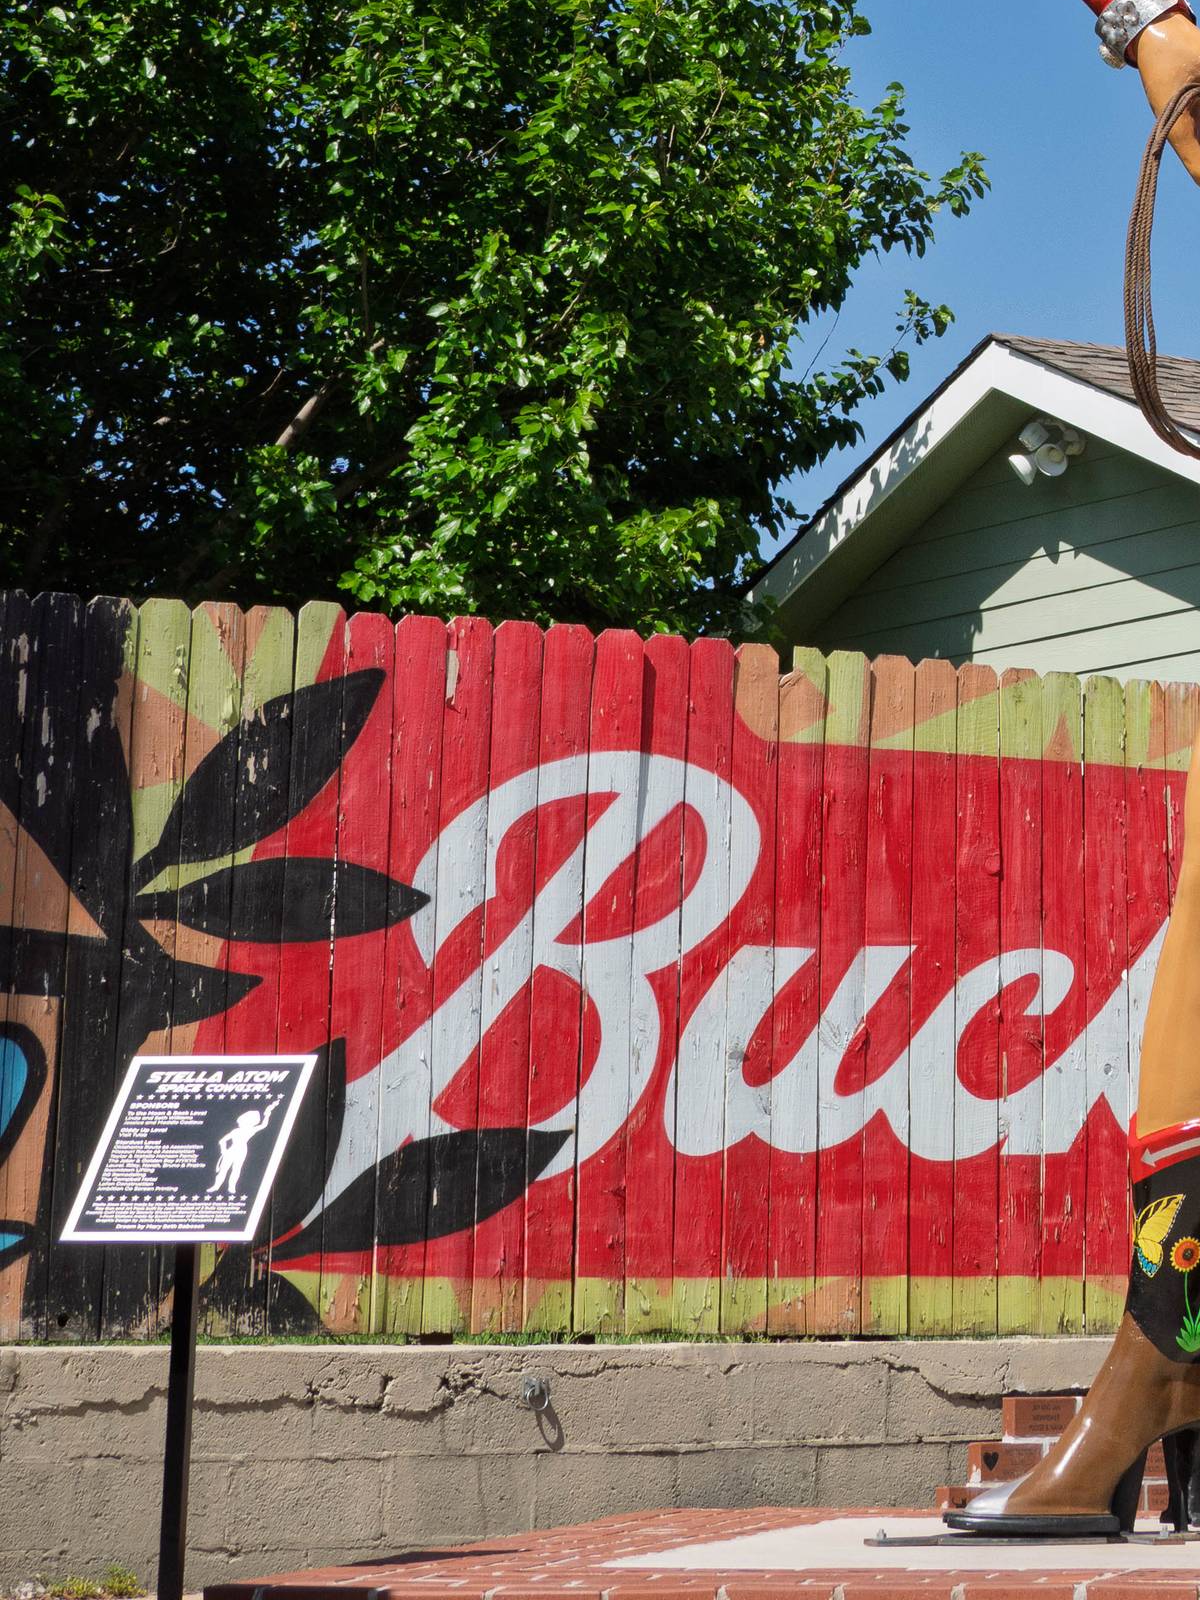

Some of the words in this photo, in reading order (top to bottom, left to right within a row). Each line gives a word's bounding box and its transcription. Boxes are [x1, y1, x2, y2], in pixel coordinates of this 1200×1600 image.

[146, 1071, 223, 1083] STELLA
[228, 1071, 289, 1083] ATOM
[156, 1083, 203, 1093] SPACE
[205, 1083, 269, 1093] COWGIRL
